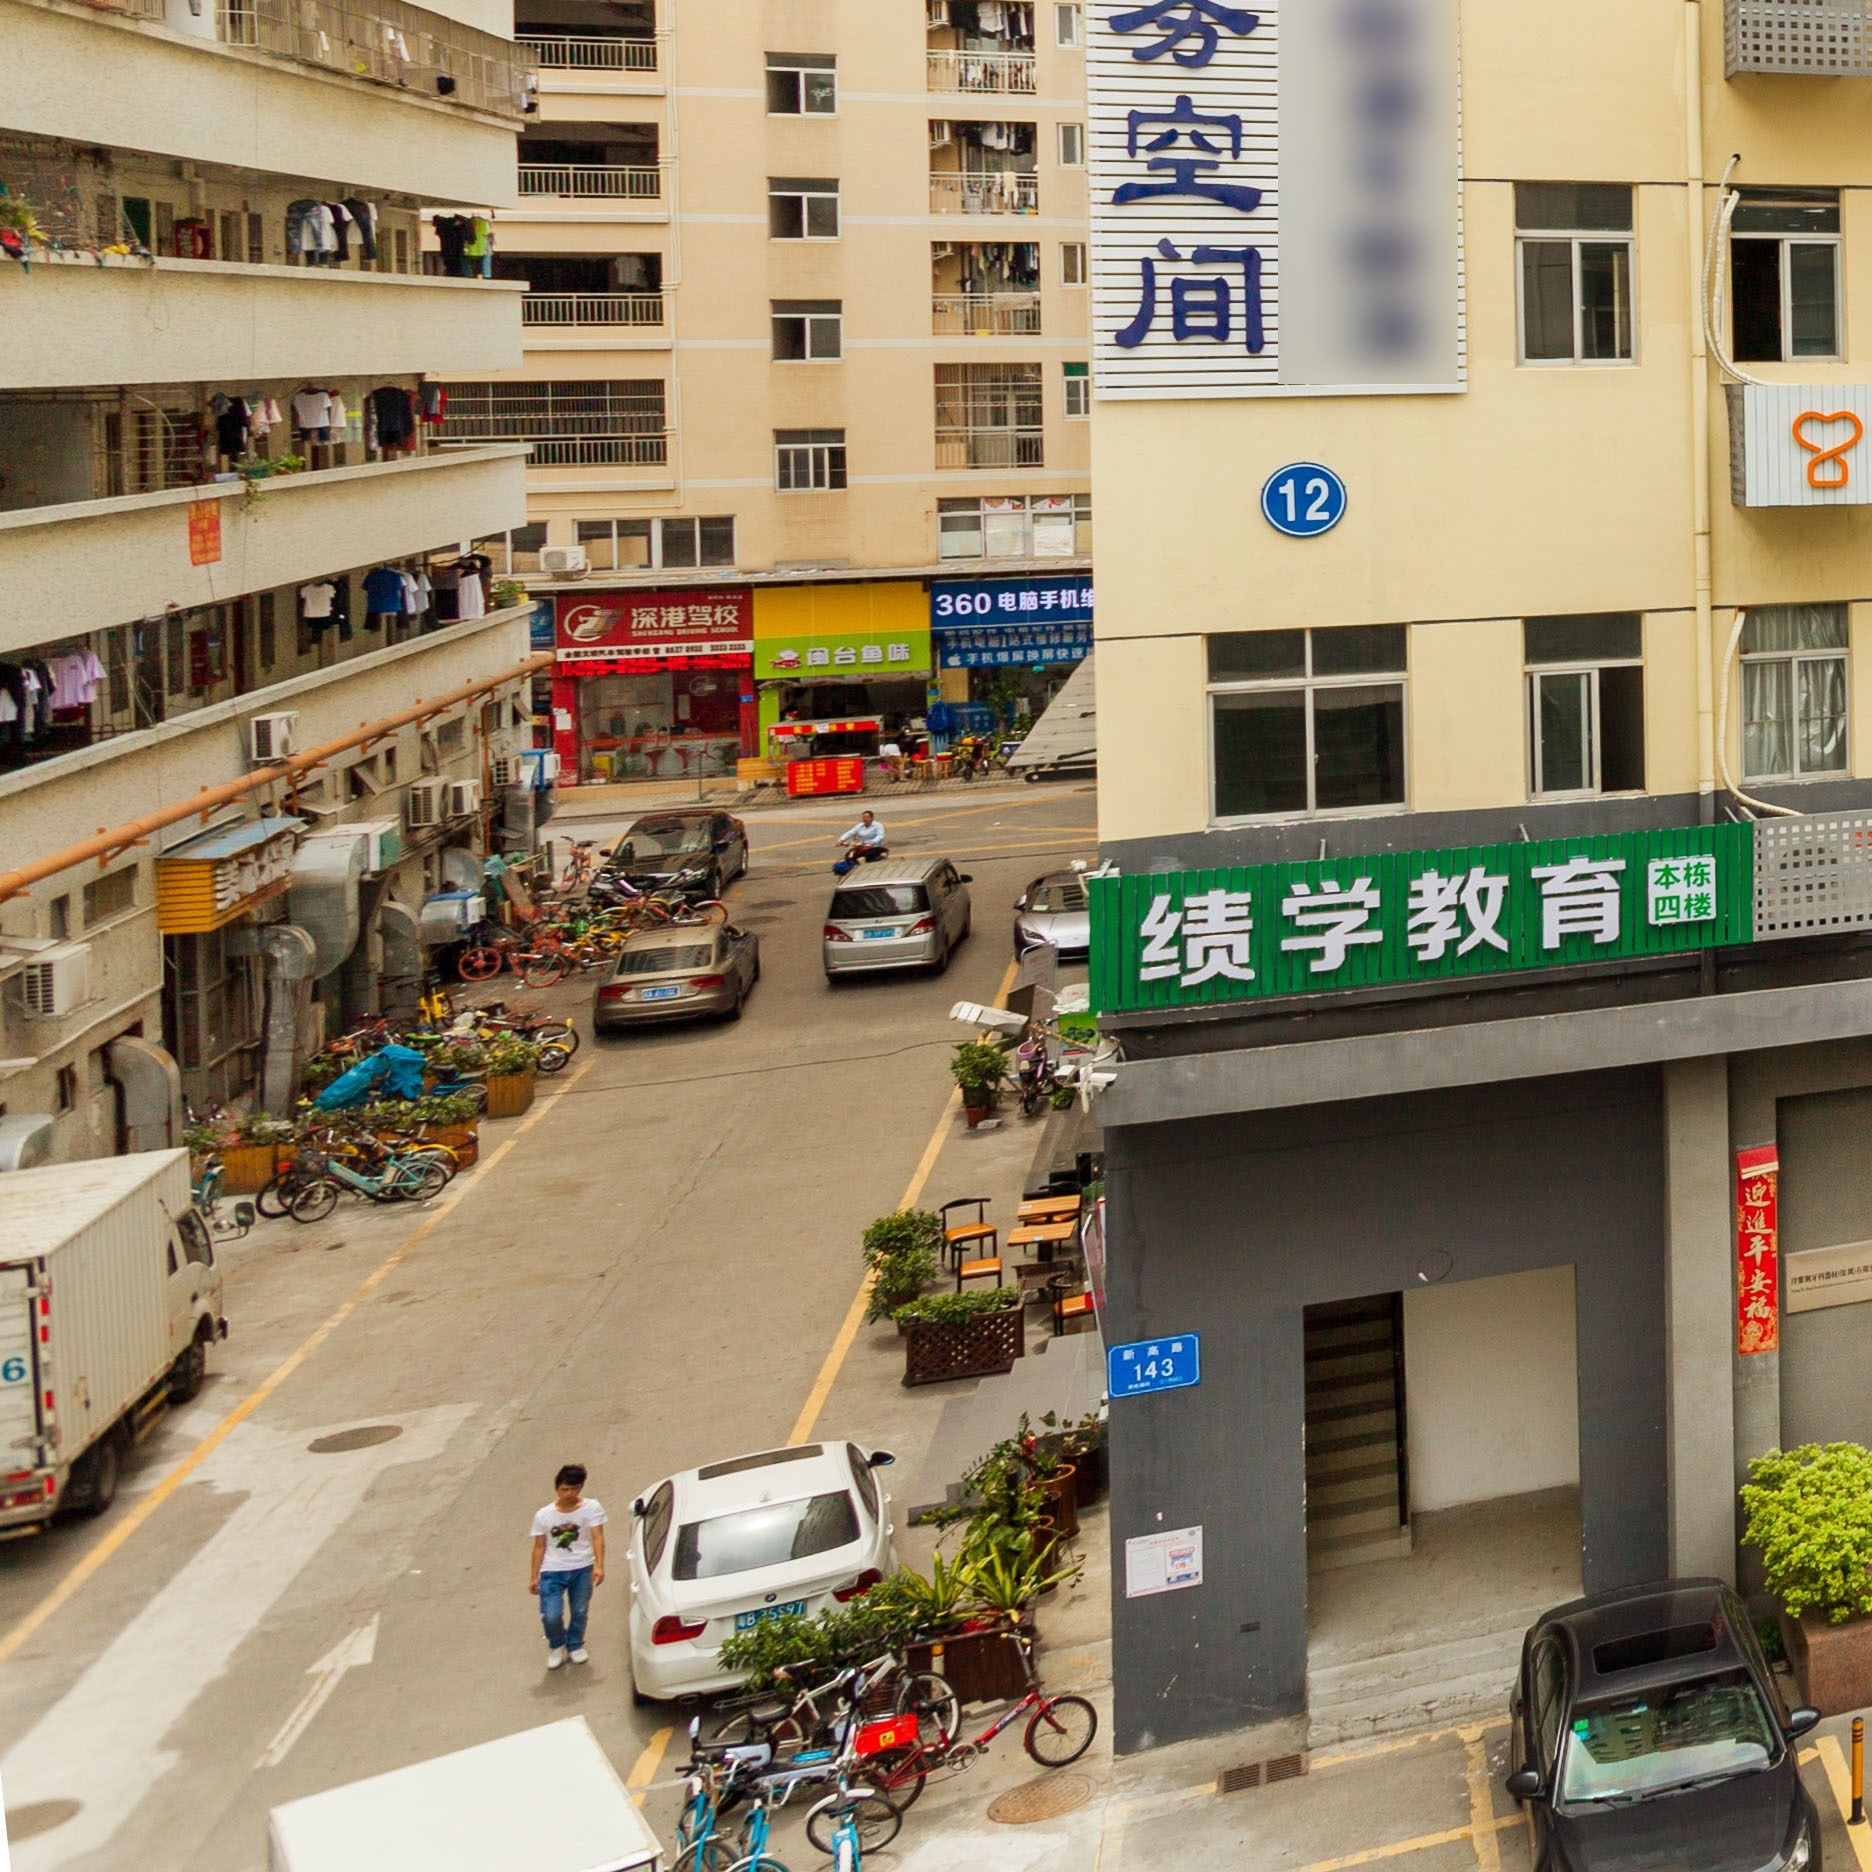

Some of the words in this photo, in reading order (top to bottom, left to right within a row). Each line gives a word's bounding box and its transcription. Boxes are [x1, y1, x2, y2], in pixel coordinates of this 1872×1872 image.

[1279, 477, 1331, 523] 12
[631, 604, 740, 629] 深港驾校
[935, 592, 992, 616] 360
[1653, 862, 1713, 891] 本栋
[1653, 892, 1714, 922] 四楼
[1139, 858, 1627, 988] 绩学教育
[1123, 1341, 1183, 1361] 新高路
[2, 1356, 27, 1383] 6
[1134, 1358, 1174, 1381] 143
